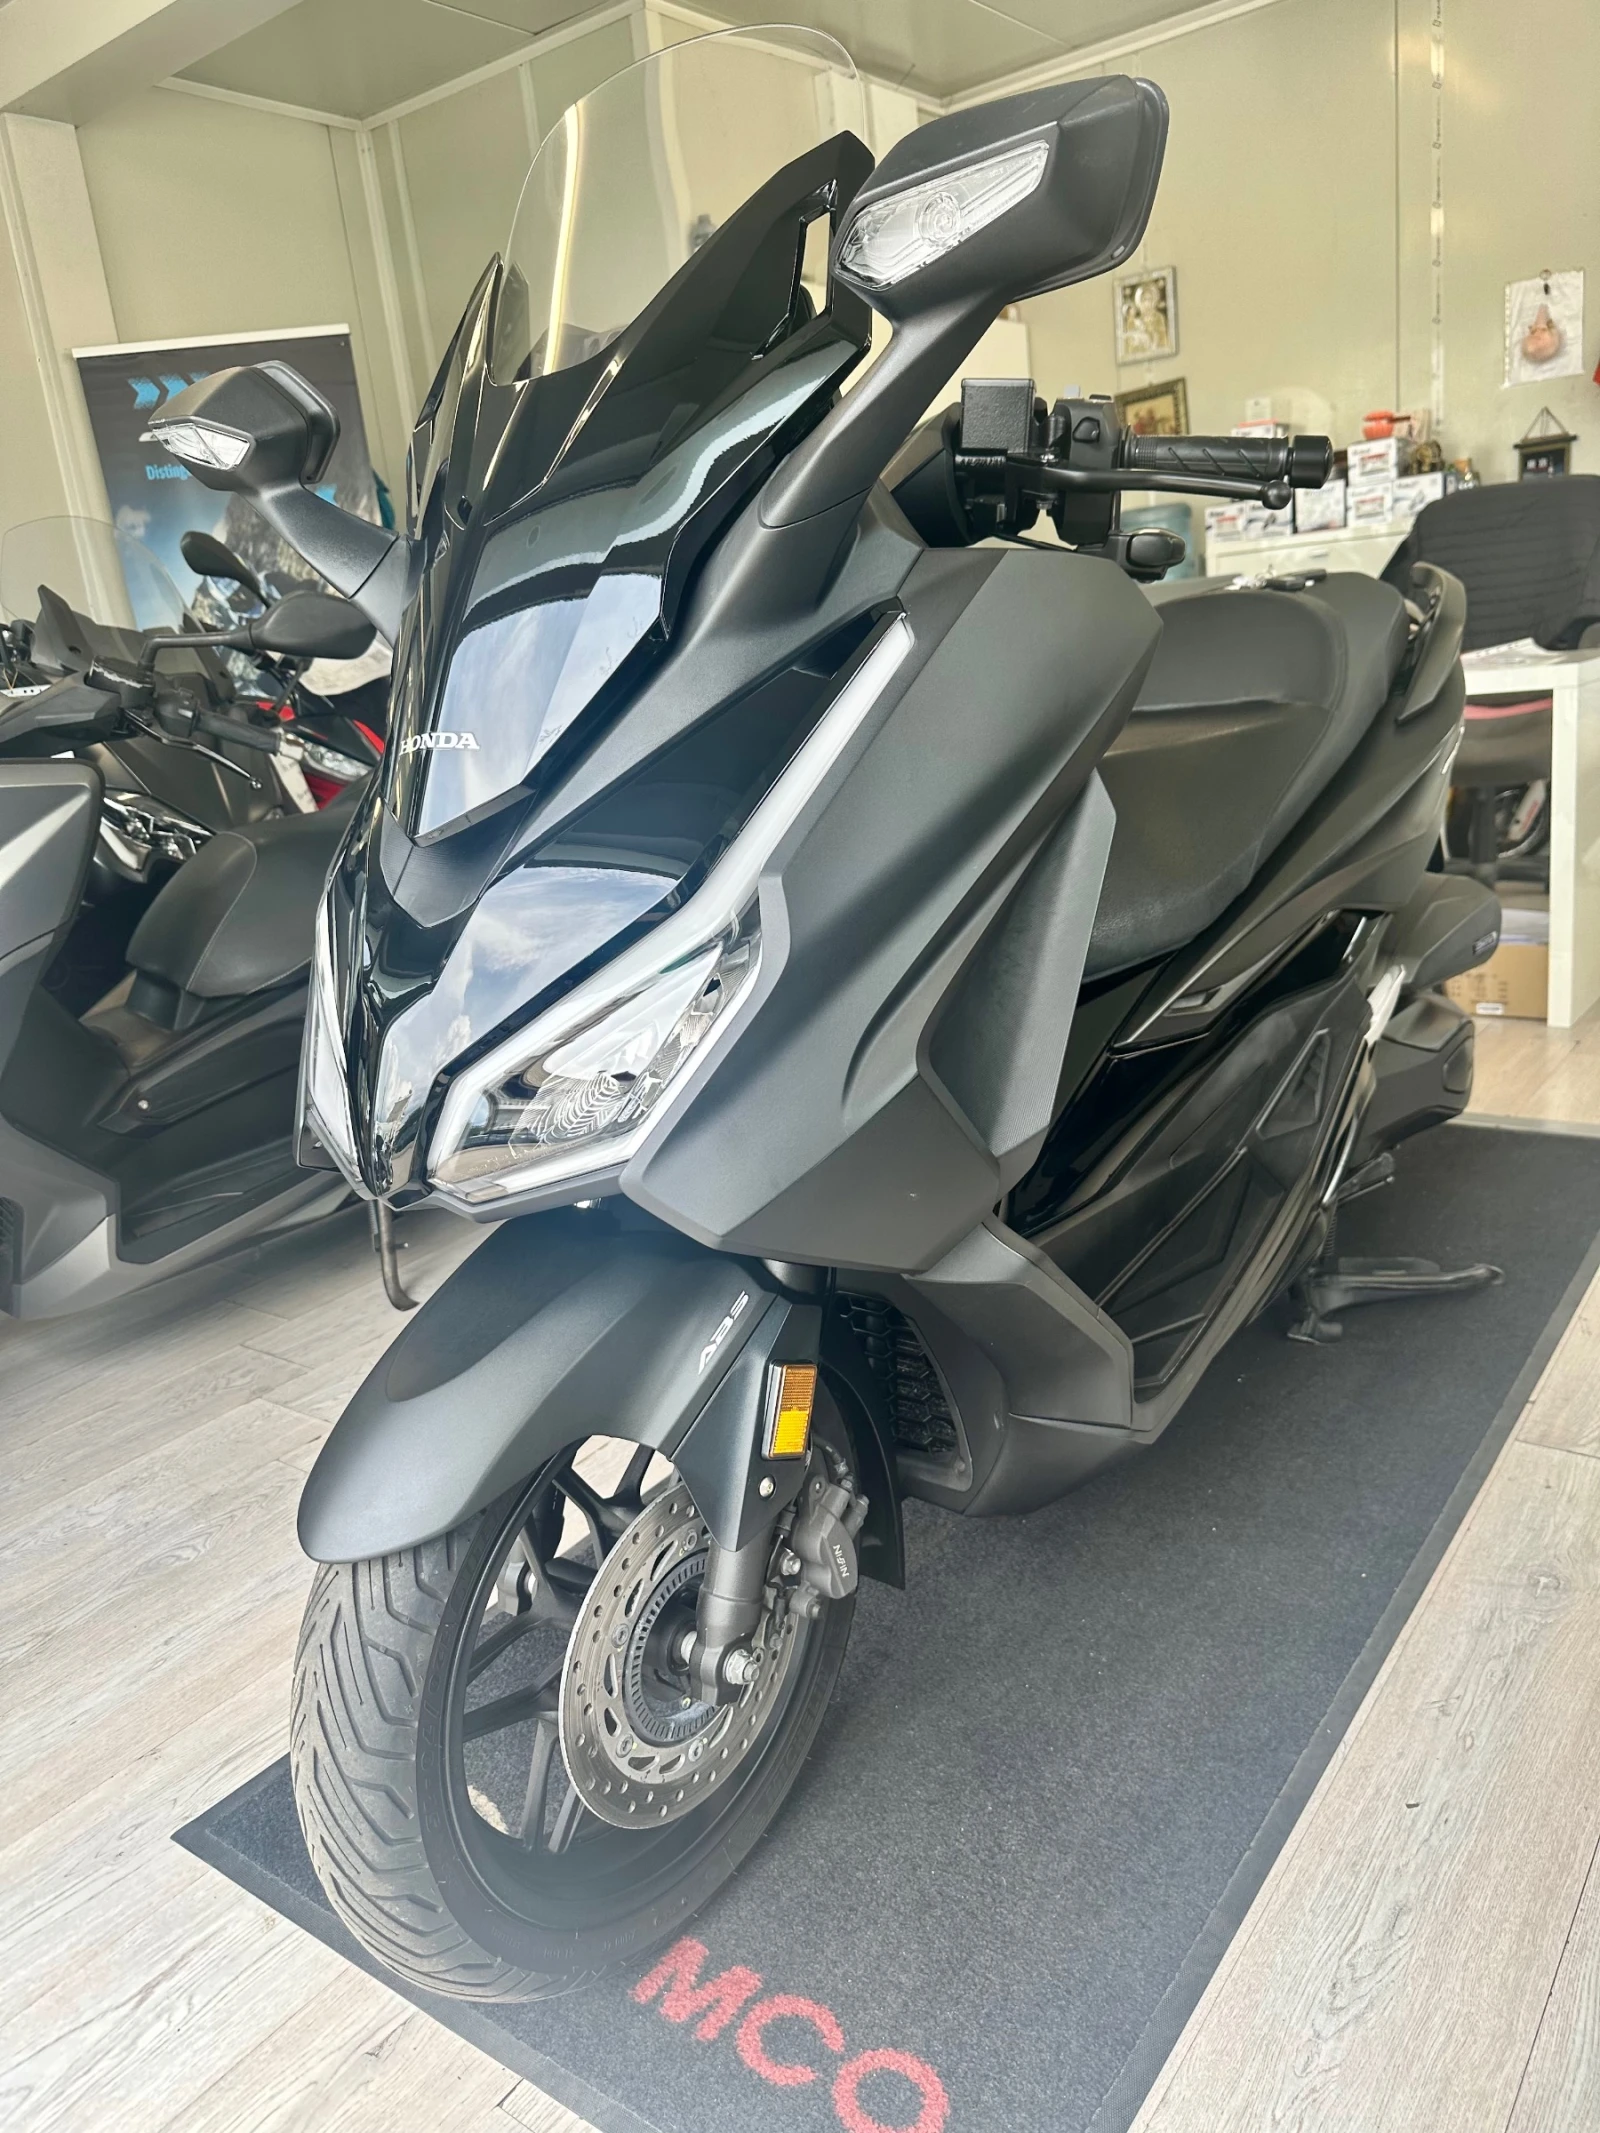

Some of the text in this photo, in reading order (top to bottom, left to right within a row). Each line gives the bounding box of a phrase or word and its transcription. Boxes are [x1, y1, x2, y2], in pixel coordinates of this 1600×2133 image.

[145, 463, 191, 481] Disting
[399, 732, 480, 756] HONDA
[697, 1290, 750, 1375] ABS
[629, 1936, 950, 2133] MCO
